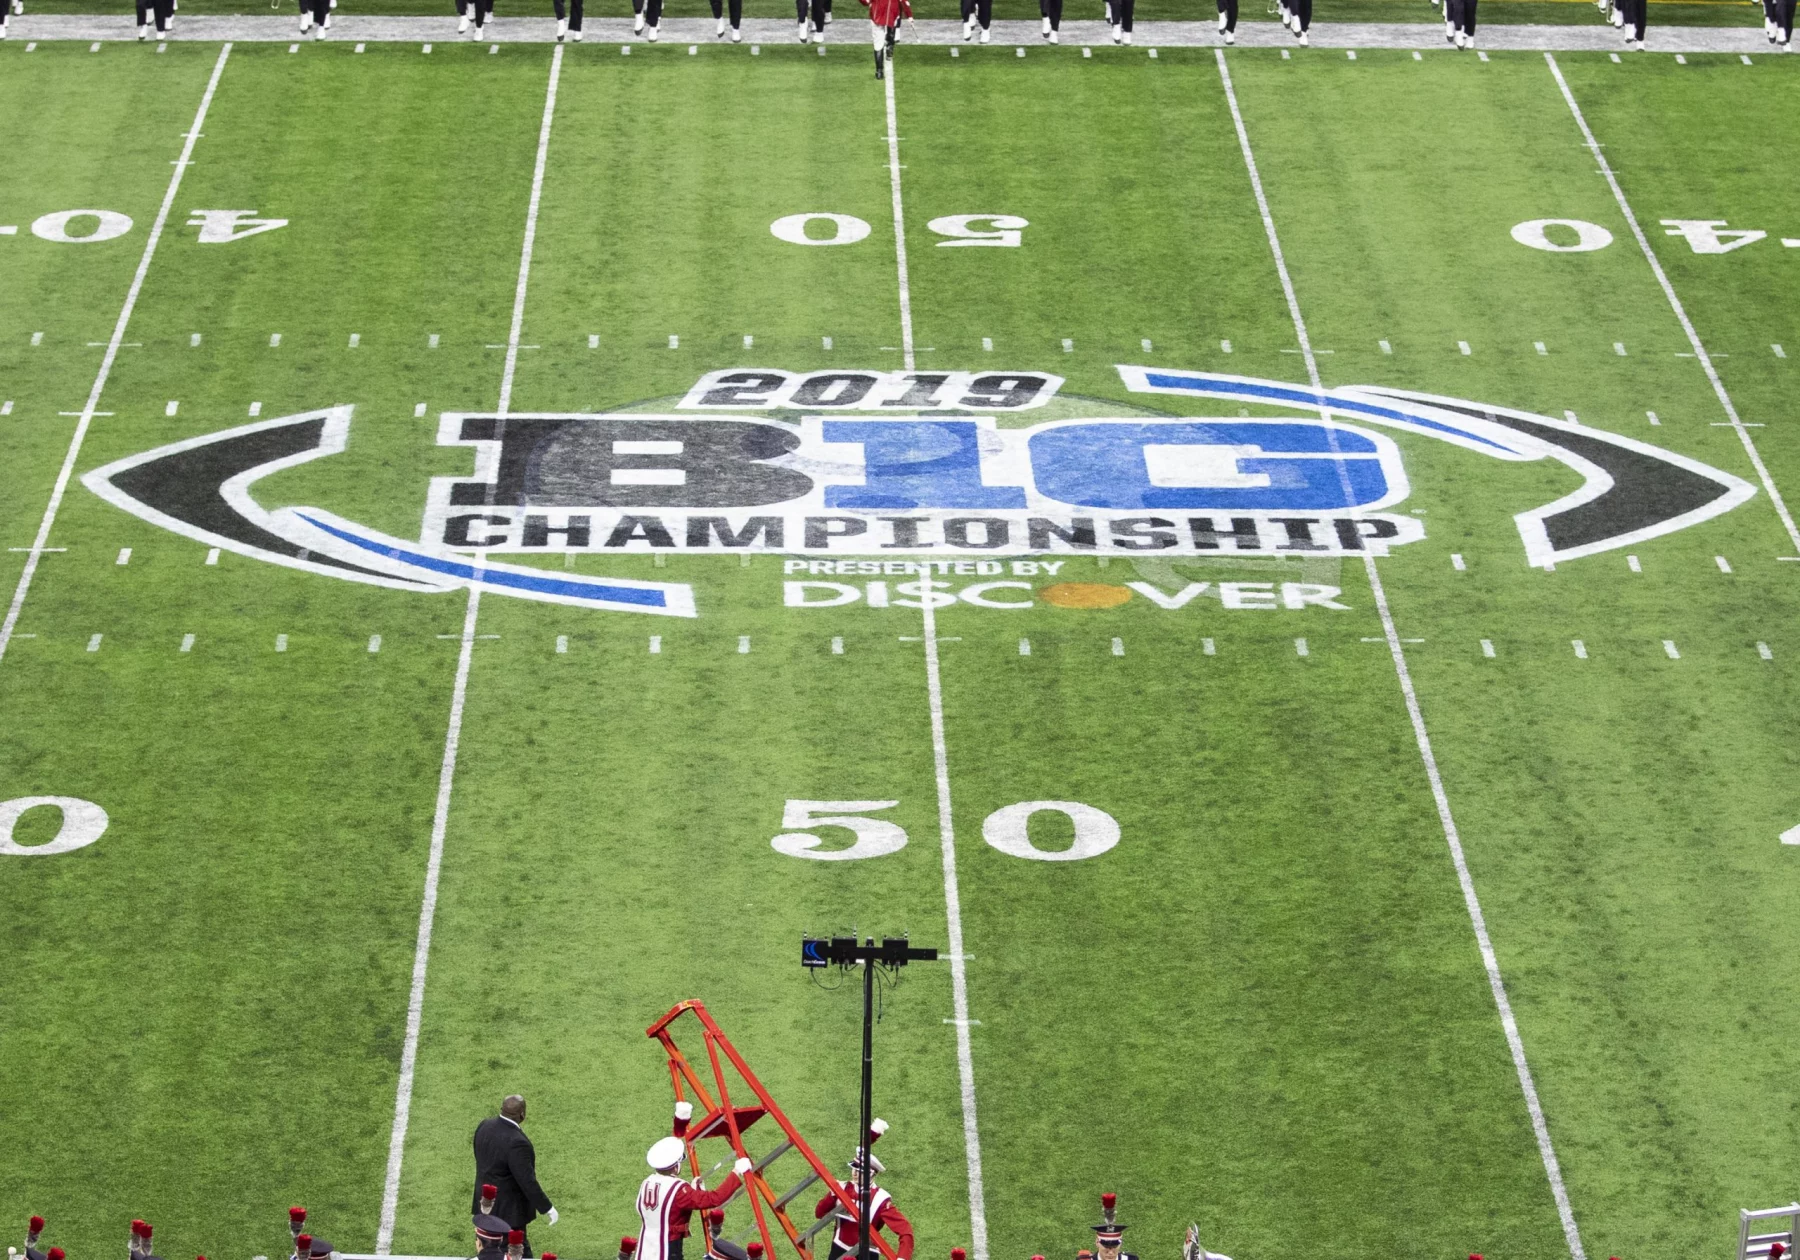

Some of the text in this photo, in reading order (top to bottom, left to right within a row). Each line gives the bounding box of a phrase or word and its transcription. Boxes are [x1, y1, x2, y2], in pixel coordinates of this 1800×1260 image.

[698, 372, 1048, 407] 2019
[443, 514, 1399, 551] CHAMPIONSHIP
[783, 560, 1066, 576] PRESENTED BY
[783, 580, 1352, 610] DISCOVER
[643, 1181, 661, 1212] W
